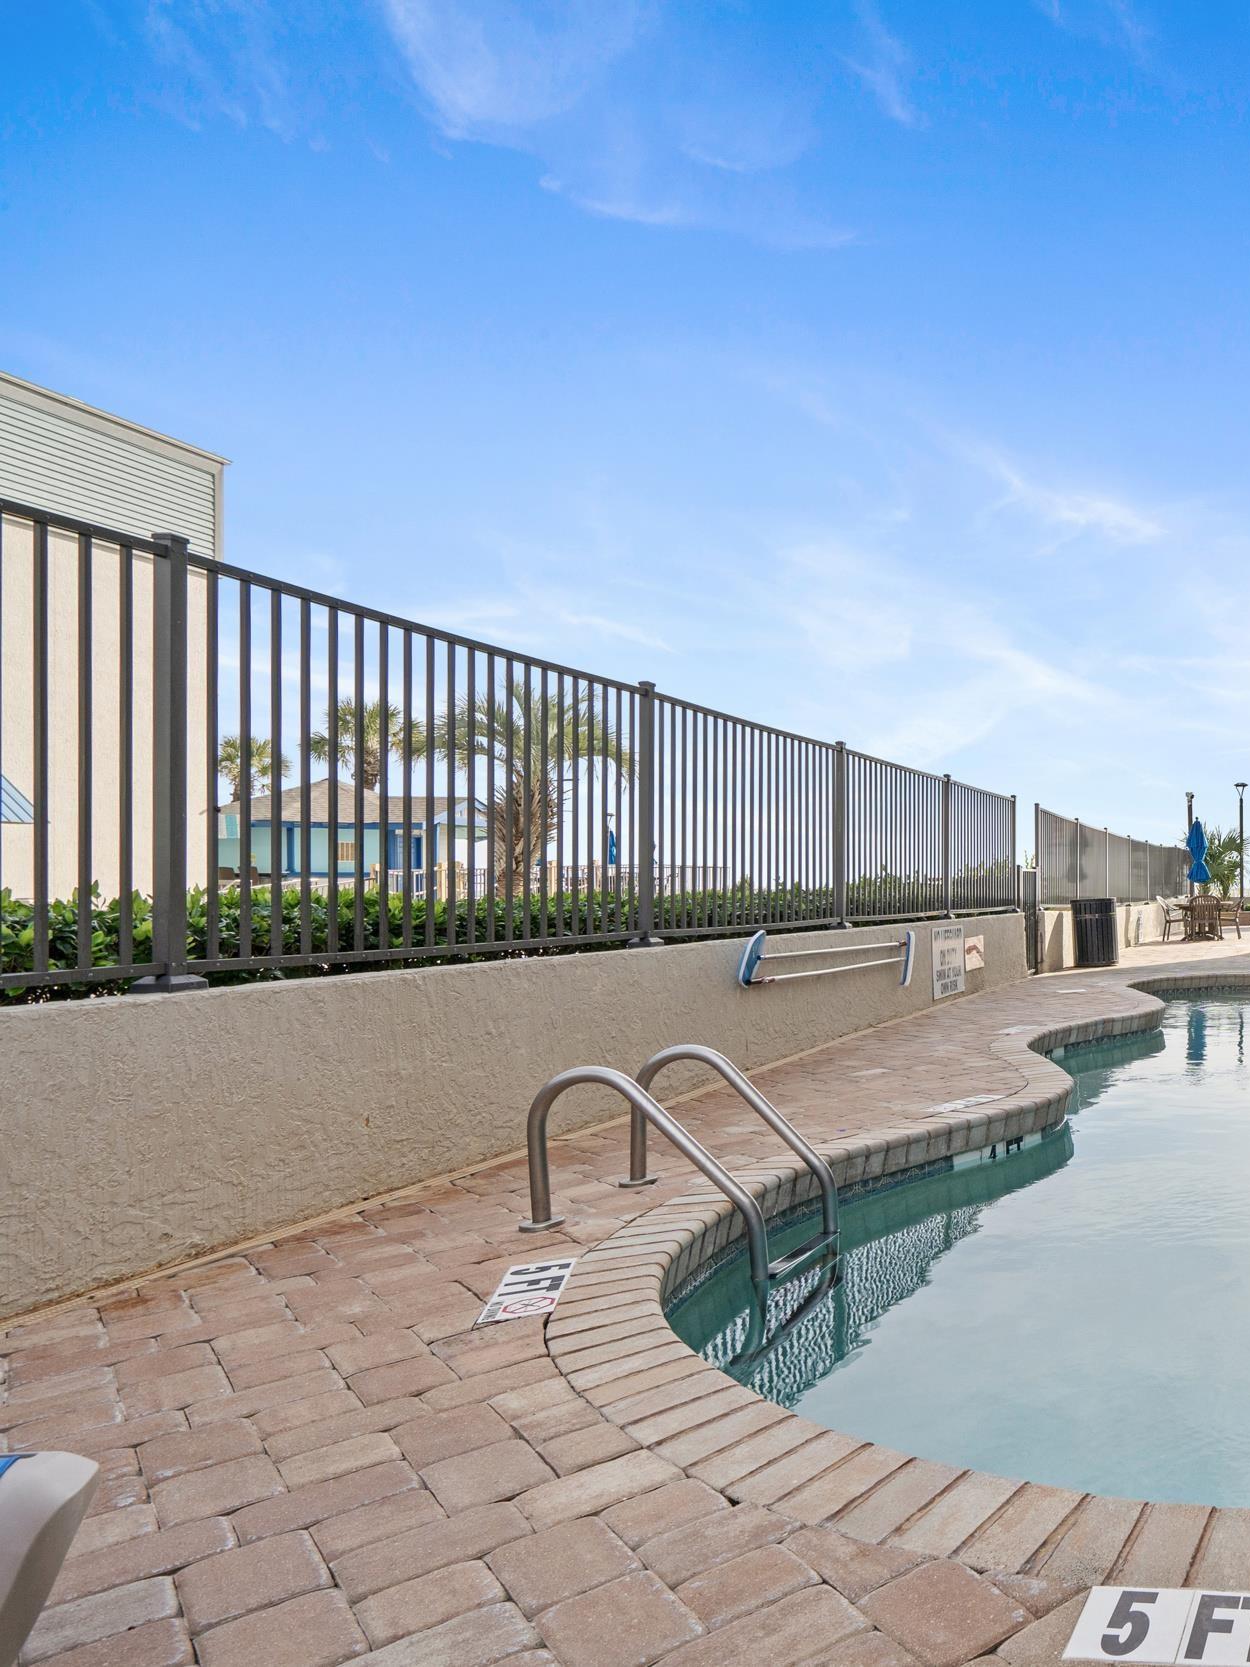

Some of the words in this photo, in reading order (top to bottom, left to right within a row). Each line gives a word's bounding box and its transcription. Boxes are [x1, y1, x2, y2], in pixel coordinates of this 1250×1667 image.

[510, 1262, 571, 1275] 5
[497, 1274, 566, 1297] FT
[1100, 1590, 1160, 1656] 5
